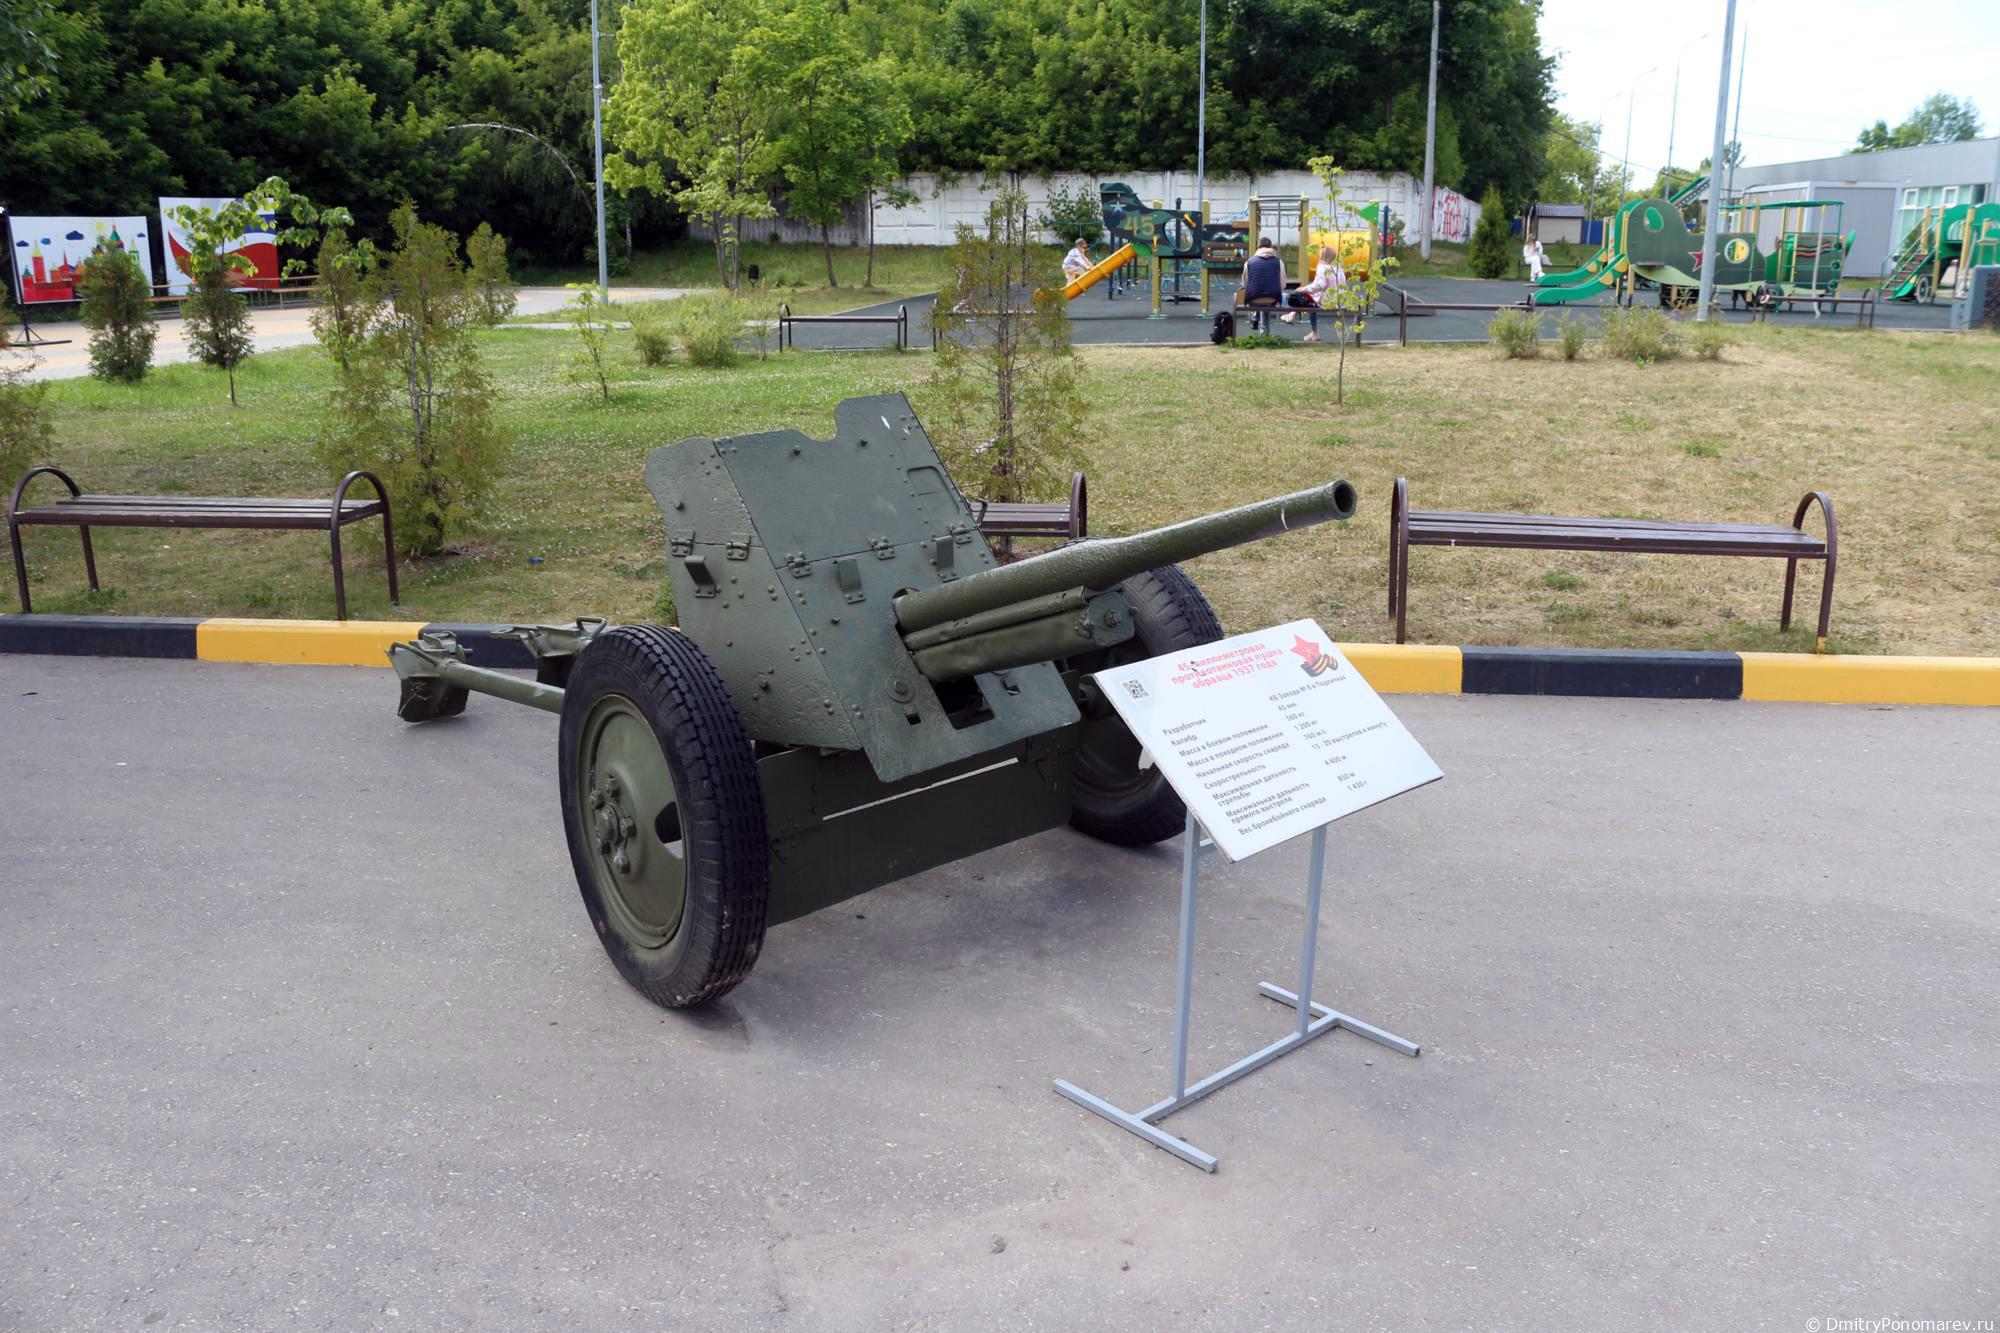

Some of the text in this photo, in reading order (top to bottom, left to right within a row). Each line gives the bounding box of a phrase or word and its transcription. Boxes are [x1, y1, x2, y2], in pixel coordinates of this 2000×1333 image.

[1254, 648, 1283, 661] пушка
[1193, 659, 1278, 688] образца 1937 года
[1162, 718, 1207, 736] Разработчик
[1171, 734, 1198, 746] Калибр
[1179, 746, 1201, 757] Масса
[1206, 736, 1232, 749] боевом
[1232, 723, 1268, 739] положении
[1187, 757, 1209, 768] Масса
[1215, 743, 1248, 759] походном
[1248, 731, 1283, 747] положении
[1195, 742, 1290, 779] Начальная скорость снаряда
[1204, 764, 1266, 790] Скорострельность
[1212, 766, 1297, 800] Максимальная дальность
[1217, 791, 1251, 807] стрельбы
[1225, 782, 1310, 818] Максимальная дальность
[1231, 796, 1293, 825] прямого выстрела
[1238, 796, 1327, 836] Вес бронебойного снаряда
